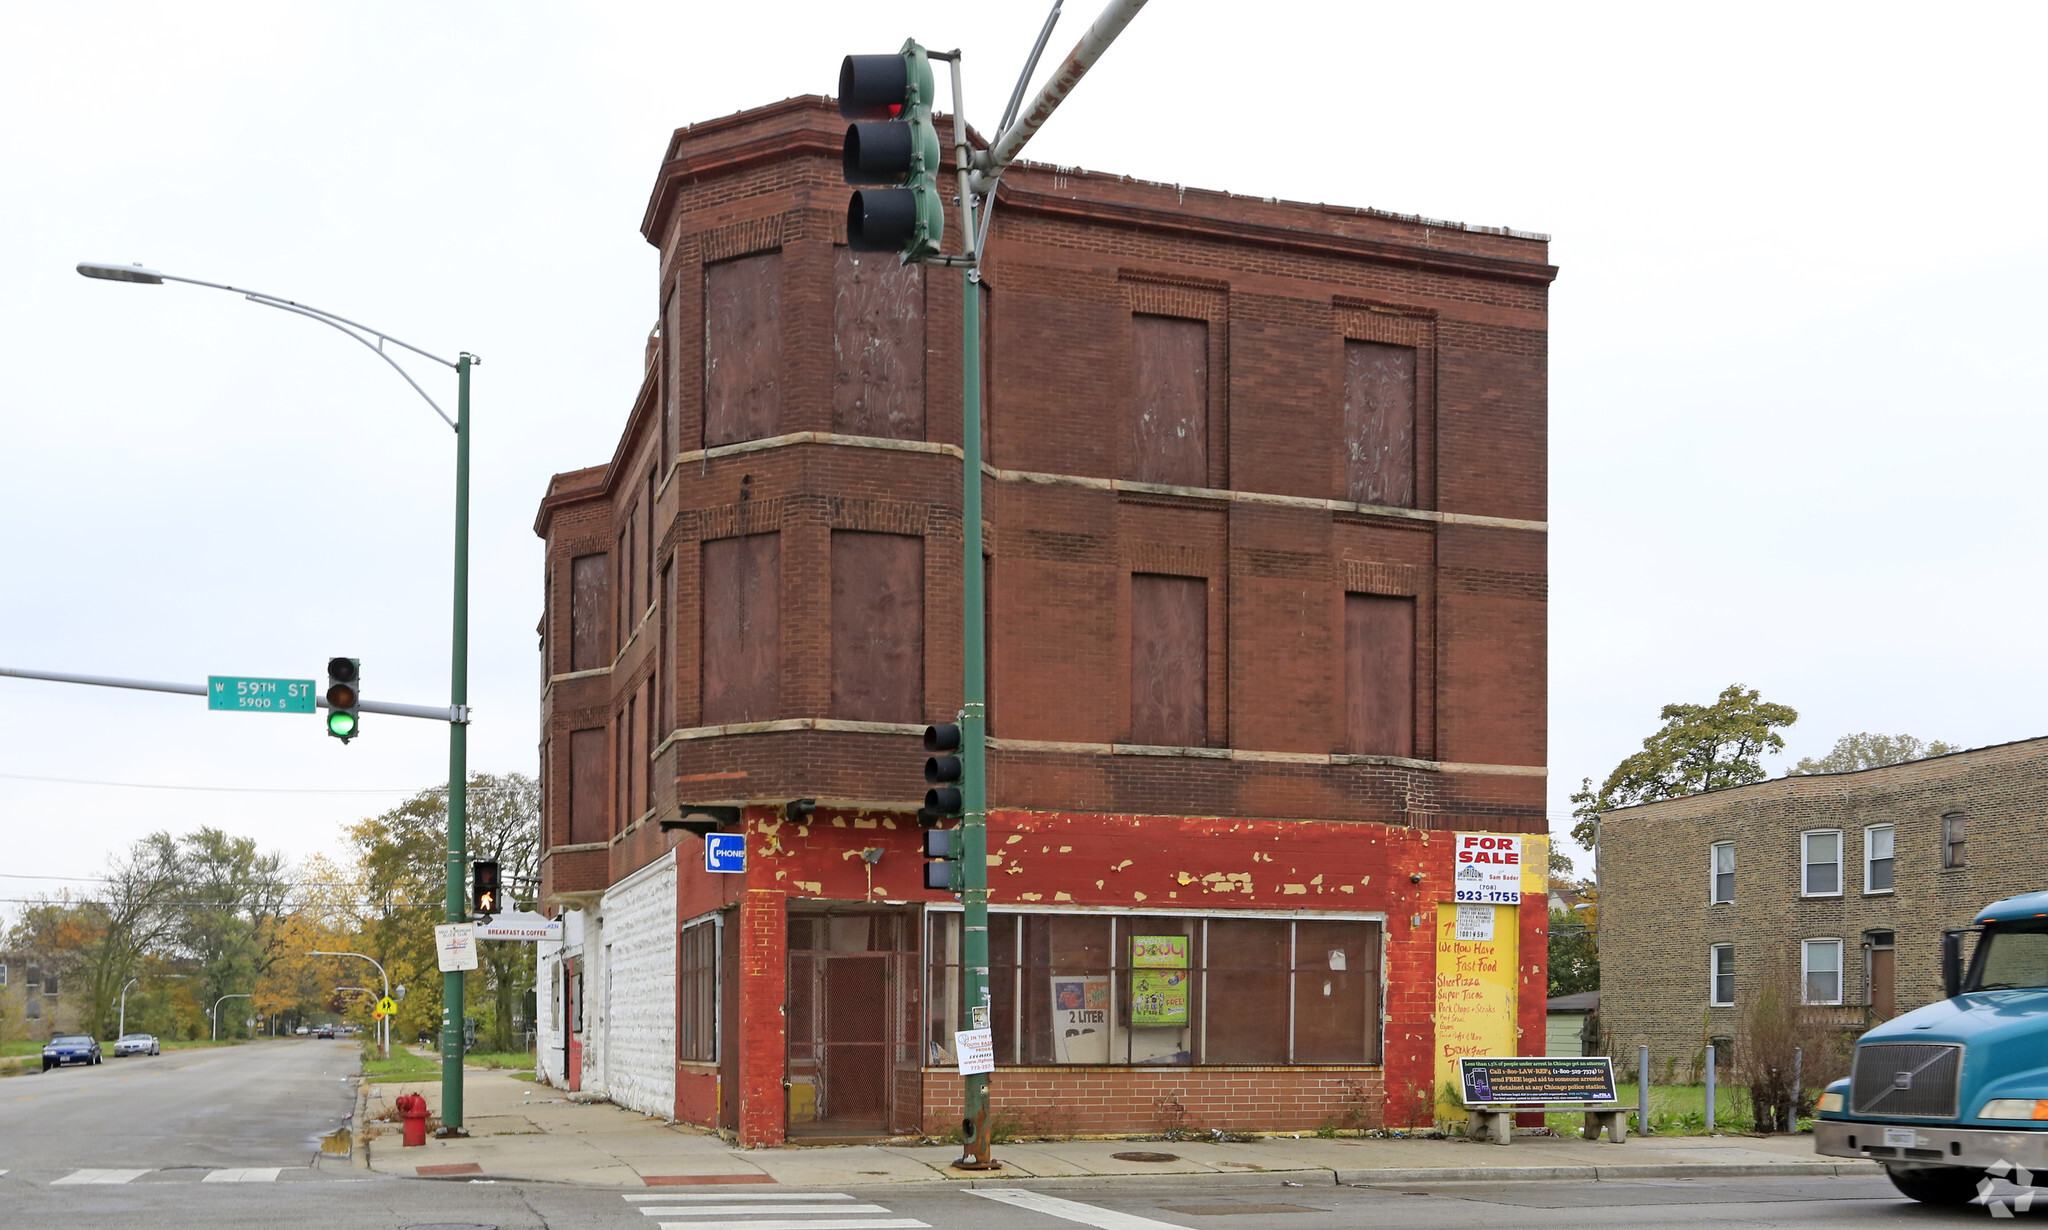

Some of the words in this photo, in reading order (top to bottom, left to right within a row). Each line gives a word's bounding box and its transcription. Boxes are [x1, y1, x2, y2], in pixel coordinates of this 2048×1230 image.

[215, 682, 225, 693] W
[237, 681, 276, 696] 59TH
[288, 684, 310, 698] ST
[239, 697, 271, 708] 5900
[279, 698, 287, 709] S
[1464, 837, 1514, 850] FOR
[715, 849, 744, 858] PHONE
[1459, 851, 1519, 865] SALE
[1456, 890, 1519, 902] 923-1755
[487, 929, 520, 937] BREAKFAST
[1136, 937, 1166, 947] every
[1438, 941, 1452, 953] We
[1454, 942, 1472, 954] Now
[1474, 941, 1495, 955] Have
[1456, 955, 1476, 972] Fast
[1478, 956, 1498, 972] Food
[1437, 988, 1460, 1002] Super
[1069, 1011, 1076, 1024] 2
[1078, 1011, 1104, 1024] LITER
